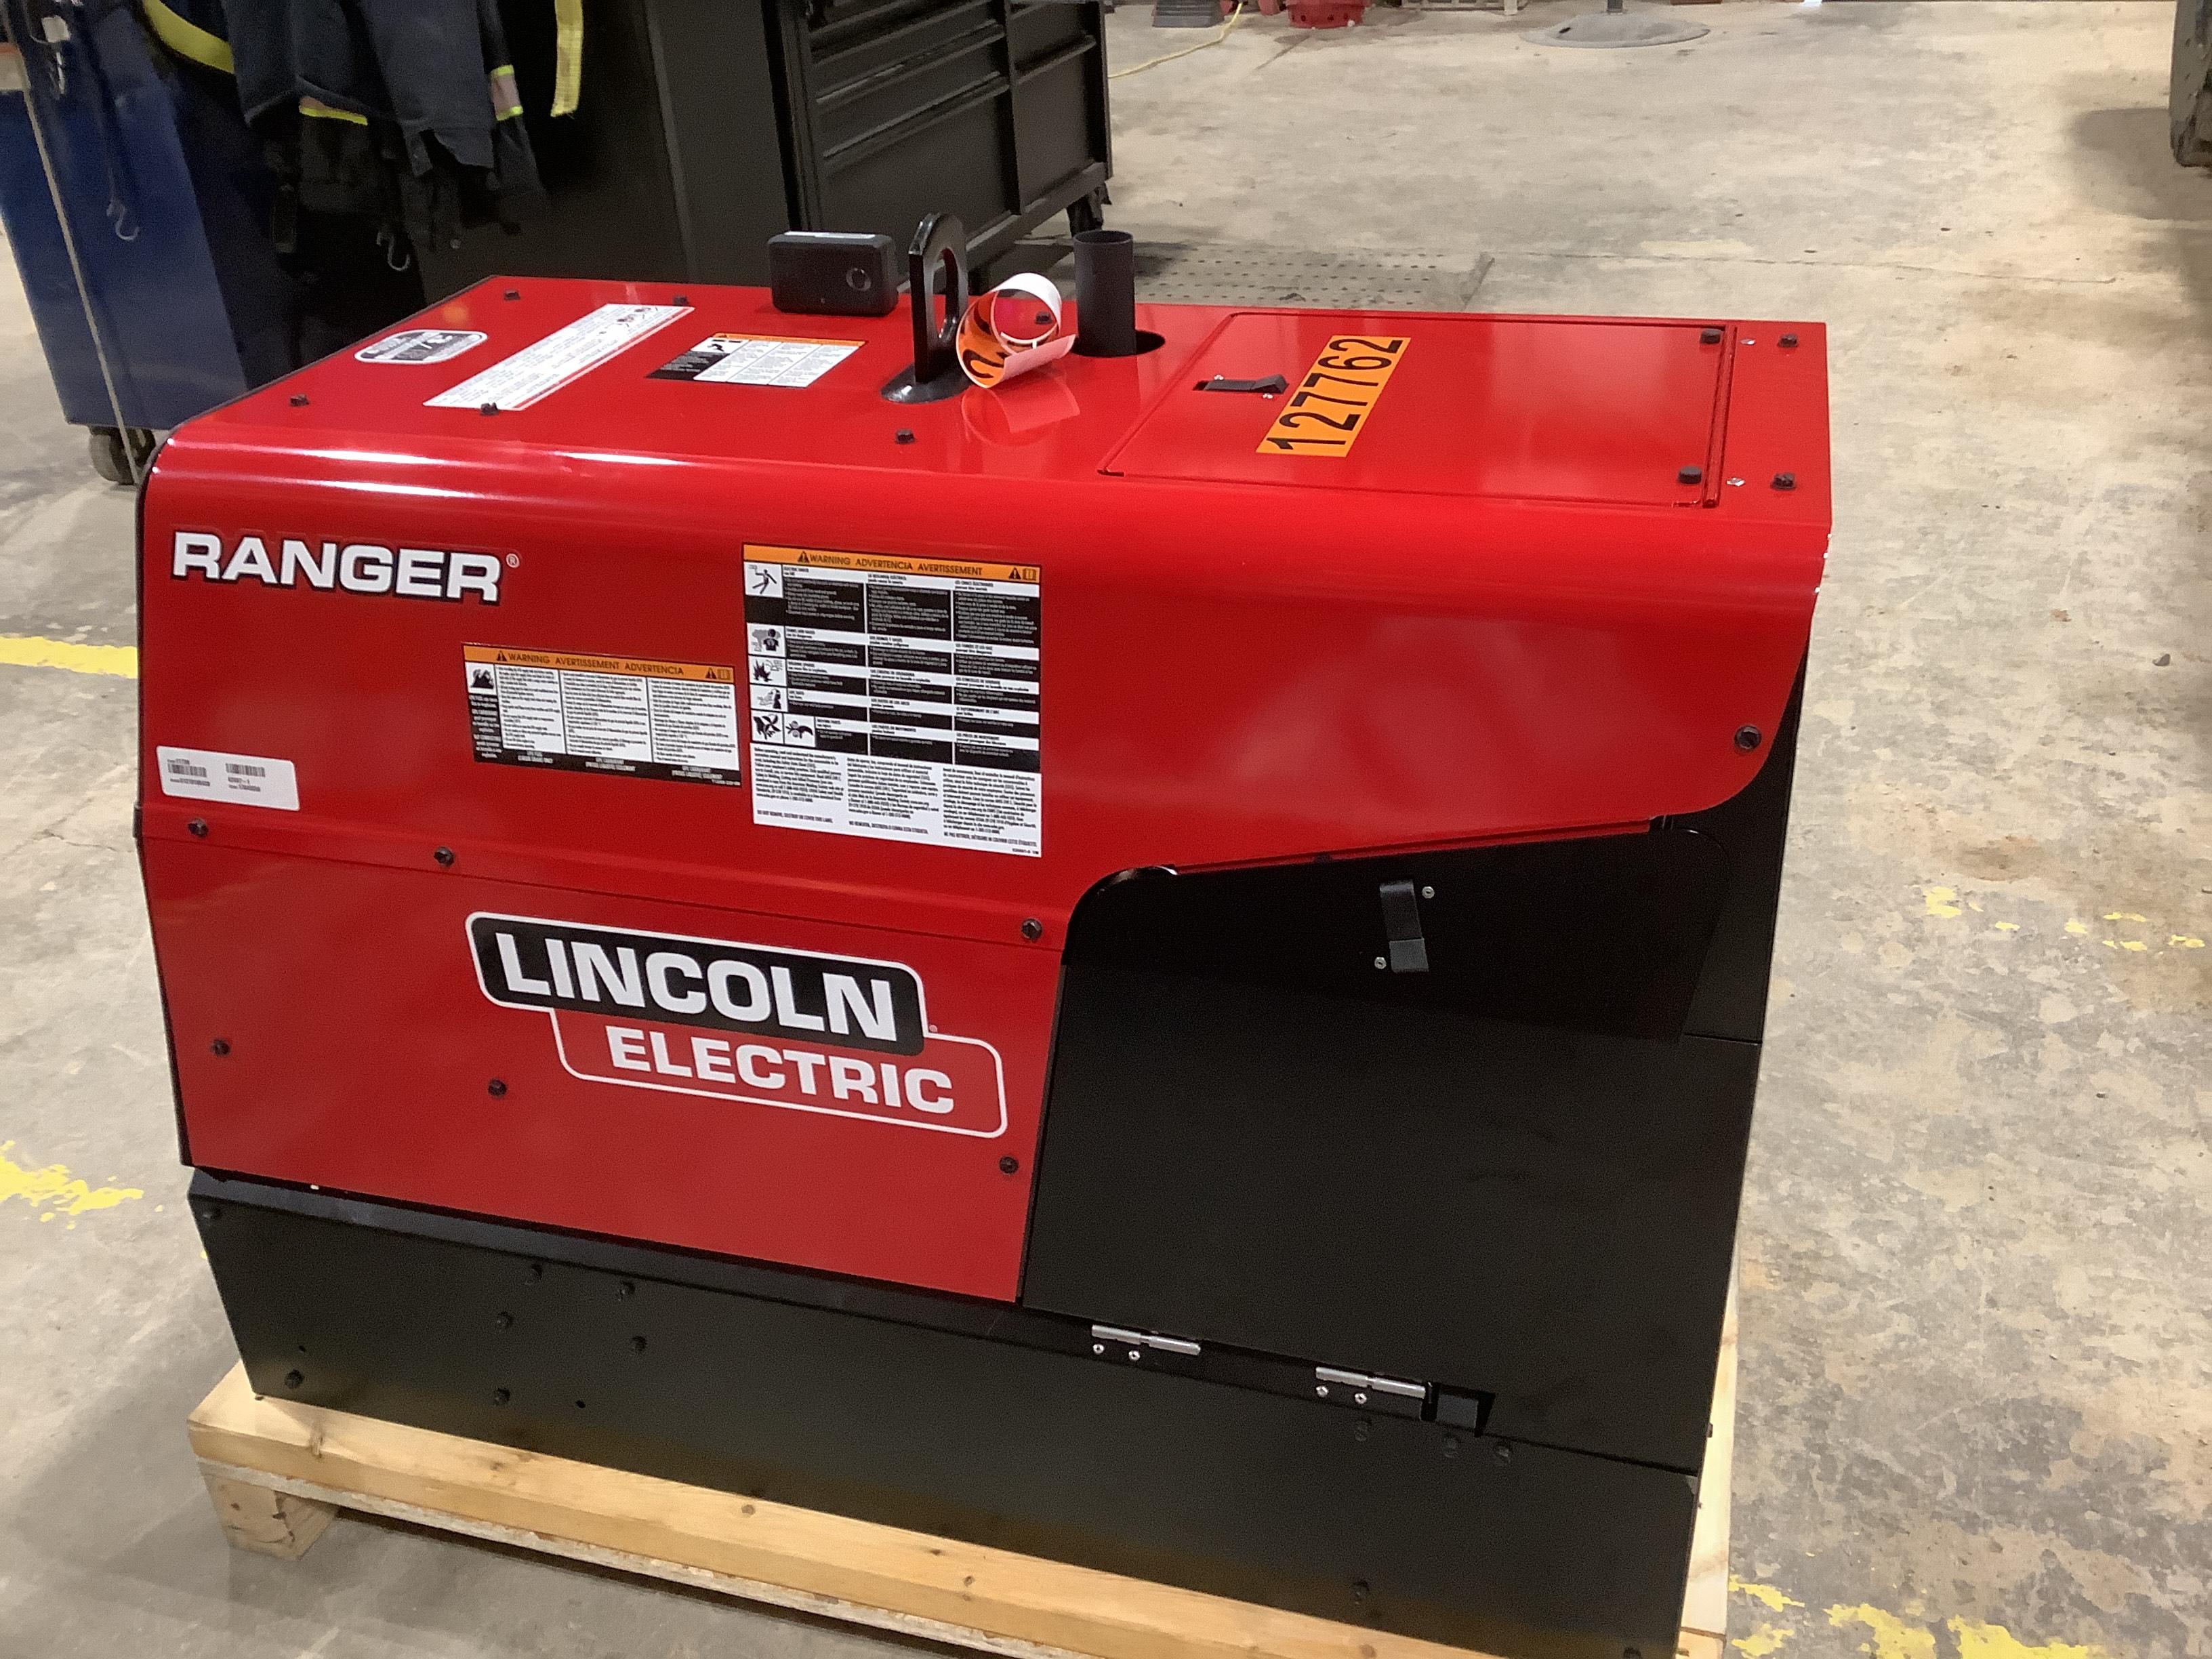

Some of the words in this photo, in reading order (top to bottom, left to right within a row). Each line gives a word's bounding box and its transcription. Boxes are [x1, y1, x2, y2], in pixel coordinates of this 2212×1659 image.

[1265, 337, 1404, 450] 127762
[809, 554, 851, 565] WARNING
[855, 558, 913, 571] ADVERTENCIA
[917, 563, 983, 576] AVERTISSEMENT
[508, 652, 550, 664] WARNING
[555, 657, 620, 670] AVERTISSEMENT
[625, 663, 684, 675] ADVERTENCIA
[495, 931, 898, 1042] LINCOLN
[605, 1025, 955, 1115] ELECTRIC
